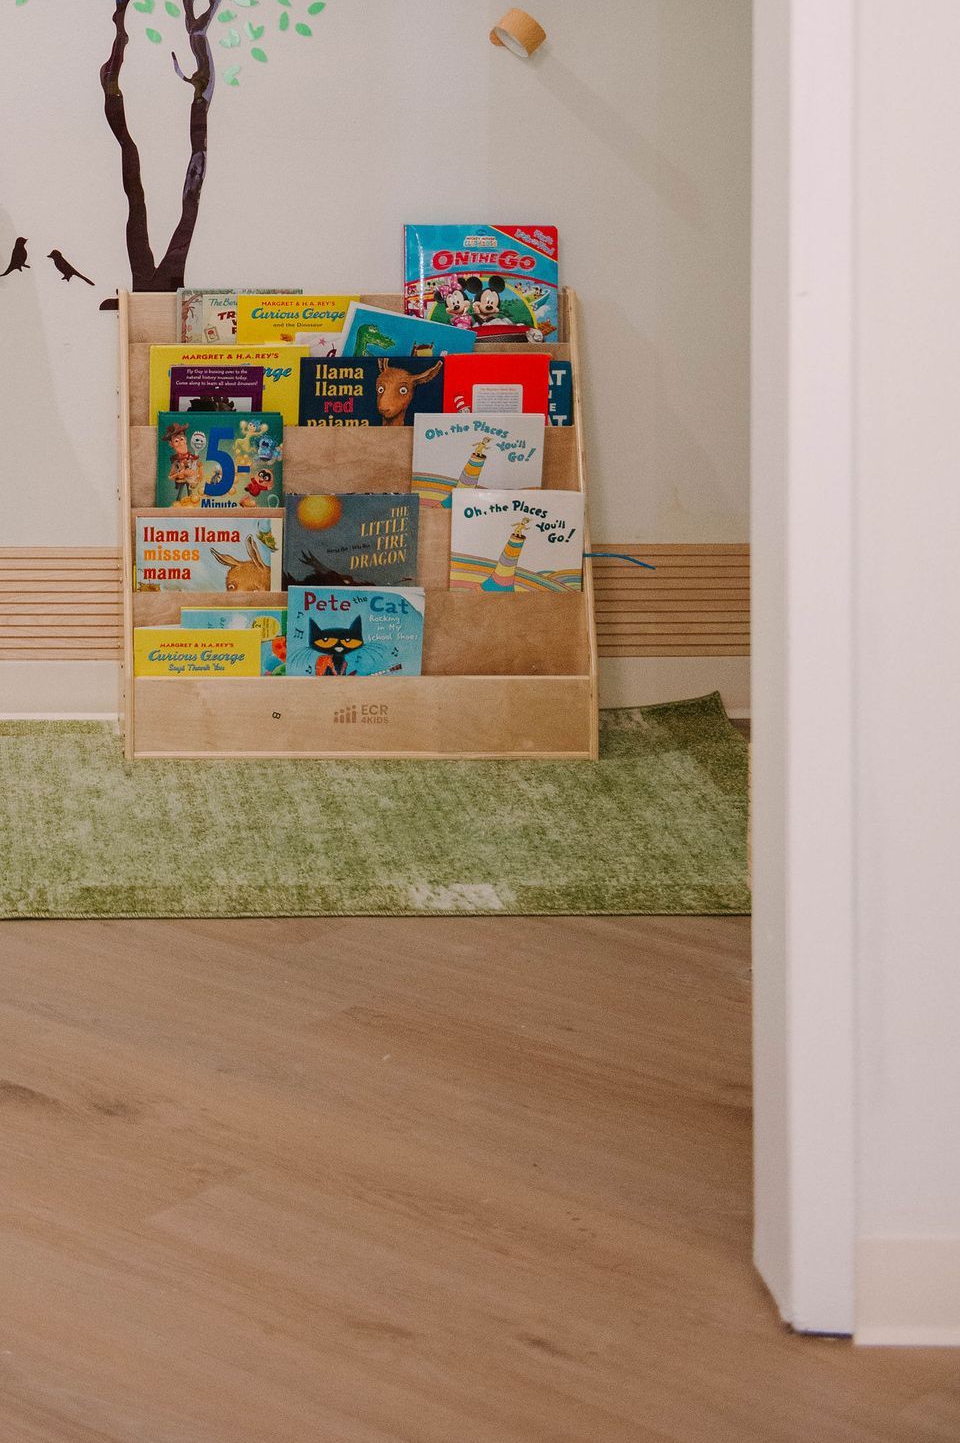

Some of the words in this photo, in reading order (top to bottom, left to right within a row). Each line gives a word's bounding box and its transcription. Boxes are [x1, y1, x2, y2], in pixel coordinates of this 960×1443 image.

[431, 250, 470, 271] ON
[470, 251, 498, 264] THE
[251, 308, 299, 320] Curious
[302, 308, 346, 322] George
[315, 364, 364, 380] llama
[315, 381, 364, 397] llama
[324, 397, 354, 413] red
[425, 428, 448, 440] Oh,
[450, 424, 470, 433] the
[473, 420, 509, 438] Places
[496, 440, 526, 452] You'll
[508, 448, 536, 462] Go!
[201, 499, 238, 508] Minute
[464, 506, 487, 518] Oh,
[489, 504, 509, 513] the
[512, 500, 548, 519] Places
[390, 506, 410, 517] THE
[361, 517, 409, 537] LITTLE
[535, 519, 566, 532] You'll
[143, 527, 189, 542] llama
[194, 527, 240, 542] llama
[376, 533, 407, 551] FIRE
[548, 528, 576, 543] Go!
[143, 544, 200, 562] misses
[349, 549, 407, 570] DRAGON
[143, 567, 191, 580] mama
[304, 591, 351, 611] Pete
[352, 596, 368, 604] the
[369, 595, 409, 615] Cat
[369, 615, 400, 624] Rocking
[148, 649, 198, 662] Curious
[199, 649, 246, 664] George
[361, 704, 389, 715] ECR
[361, 716, 390, 724] 4KIDS
